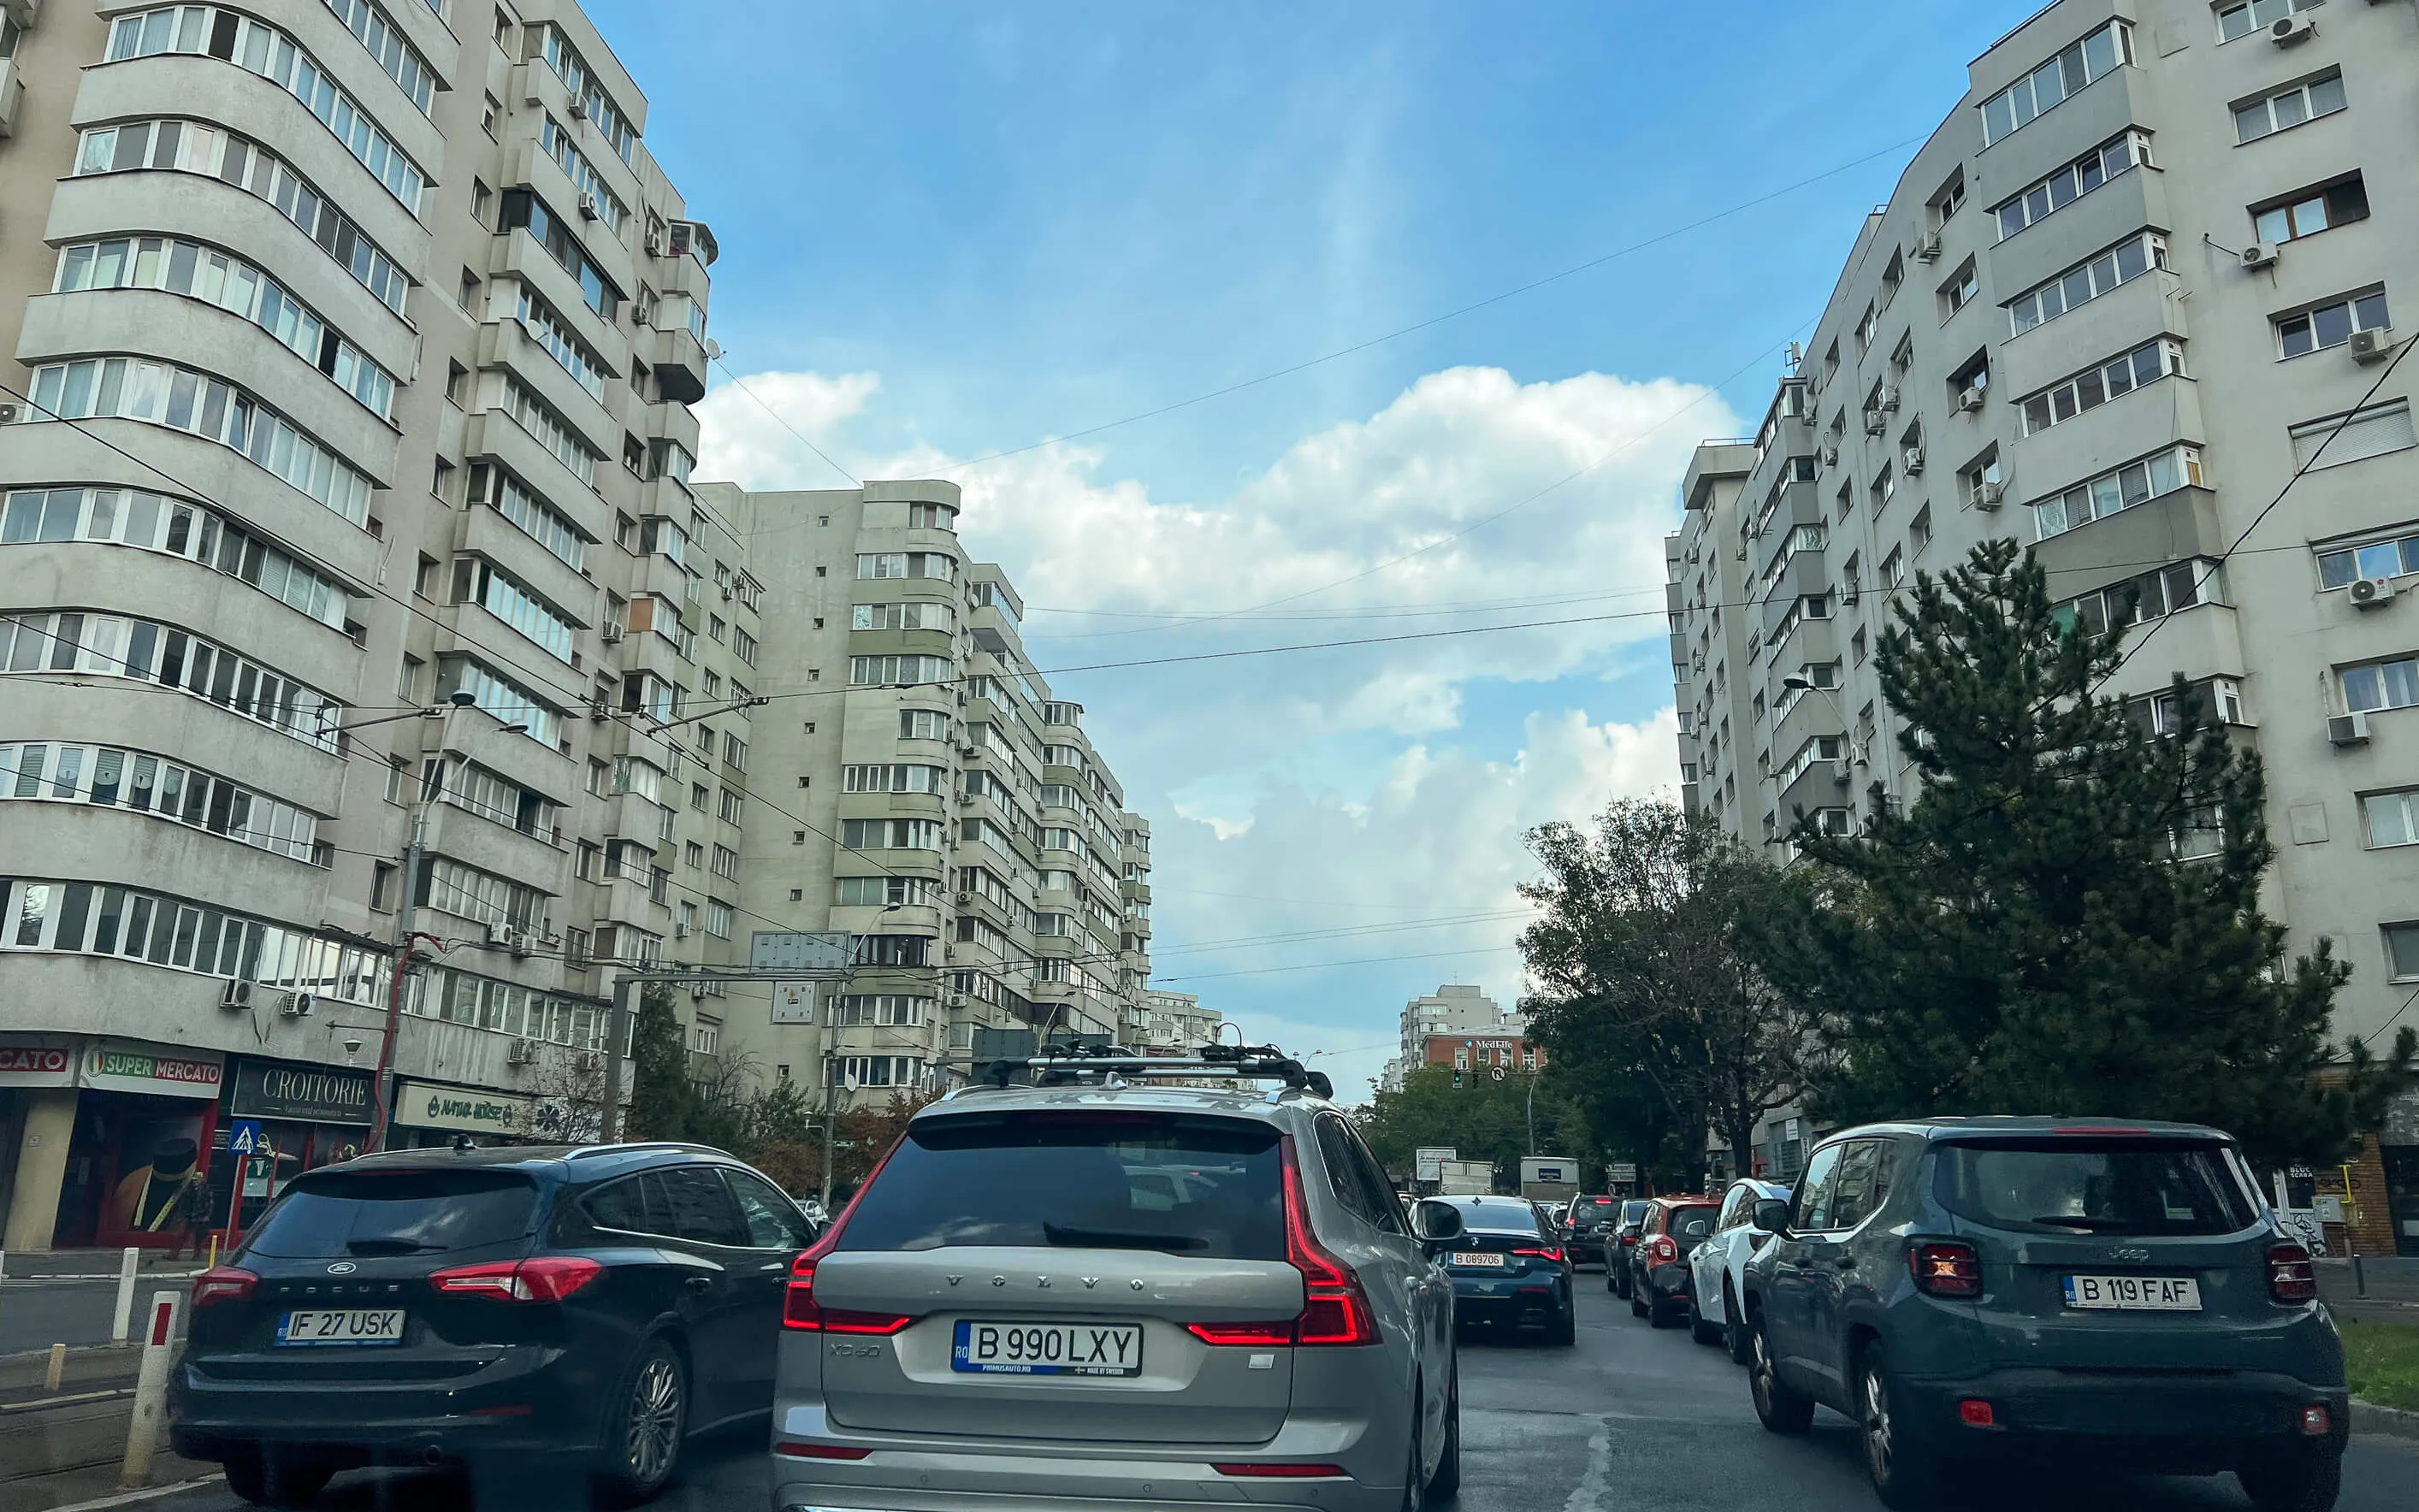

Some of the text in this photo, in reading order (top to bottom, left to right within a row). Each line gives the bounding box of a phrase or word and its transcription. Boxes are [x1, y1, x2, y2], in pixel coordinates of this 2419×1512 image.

[106, 1054, 219, 1082] SUPER MERCATO
[263, 1068, 369, 1106] CROITORIE
[1456, 1254, 1499, 1265] B 089706
[2108, 1246, 2149, 1261] Jeep
[280, 1285, 399, 1293] FOCUS
[946, 1274, 1144, 1291] VOLVO
[2082, 1279, 2188, 1302] B 119 FAF
[290, 1312, 399, 1337] IF 27 USK
[955, 1345, 968, 1360] RO
[978, 1326, 1133, 1364] B 990 LXY
